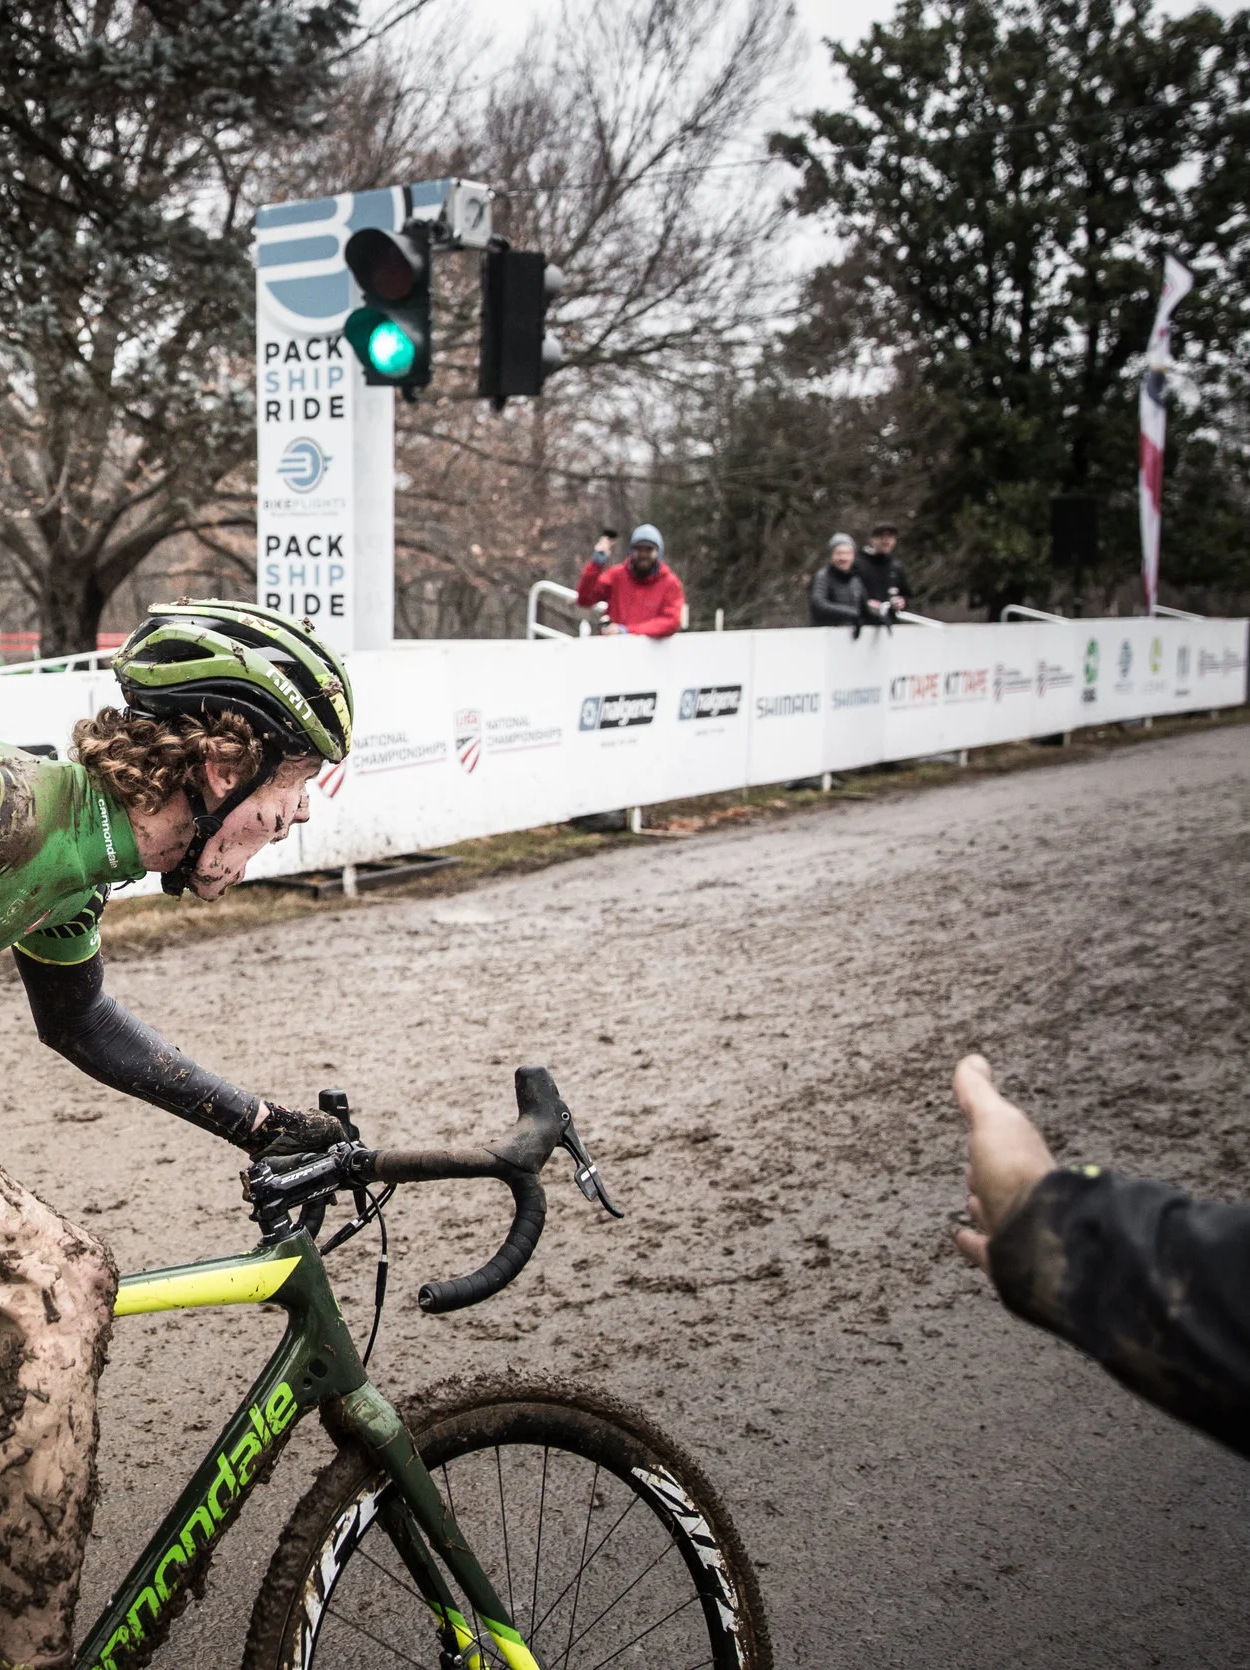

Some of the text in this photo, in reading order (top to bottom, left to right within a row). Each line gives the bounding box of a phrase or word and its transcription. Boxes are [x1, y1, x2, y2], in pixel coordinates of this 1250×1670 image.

[265, 335, 343, 364] PACK
[265, 366, 344, 393] SHIP
[266, 395, 344, 422] RIDE
[266, 534, 343, 557] PACK
[266, 564, 344, 586] SHIP
[266, 593, 345, 616] RIDE
[756, 692, 820, 719] SHIMANO
[486, 715, 530, 730] NATIONAL
[353, 732, 408, 749] NATIONAL
[485, 728, 562, 748] CHAMPIONSHIPS
[352, 742, 448, 768] CHAMPIONSHIPS
[98, 798, 119, 869] cannondale
